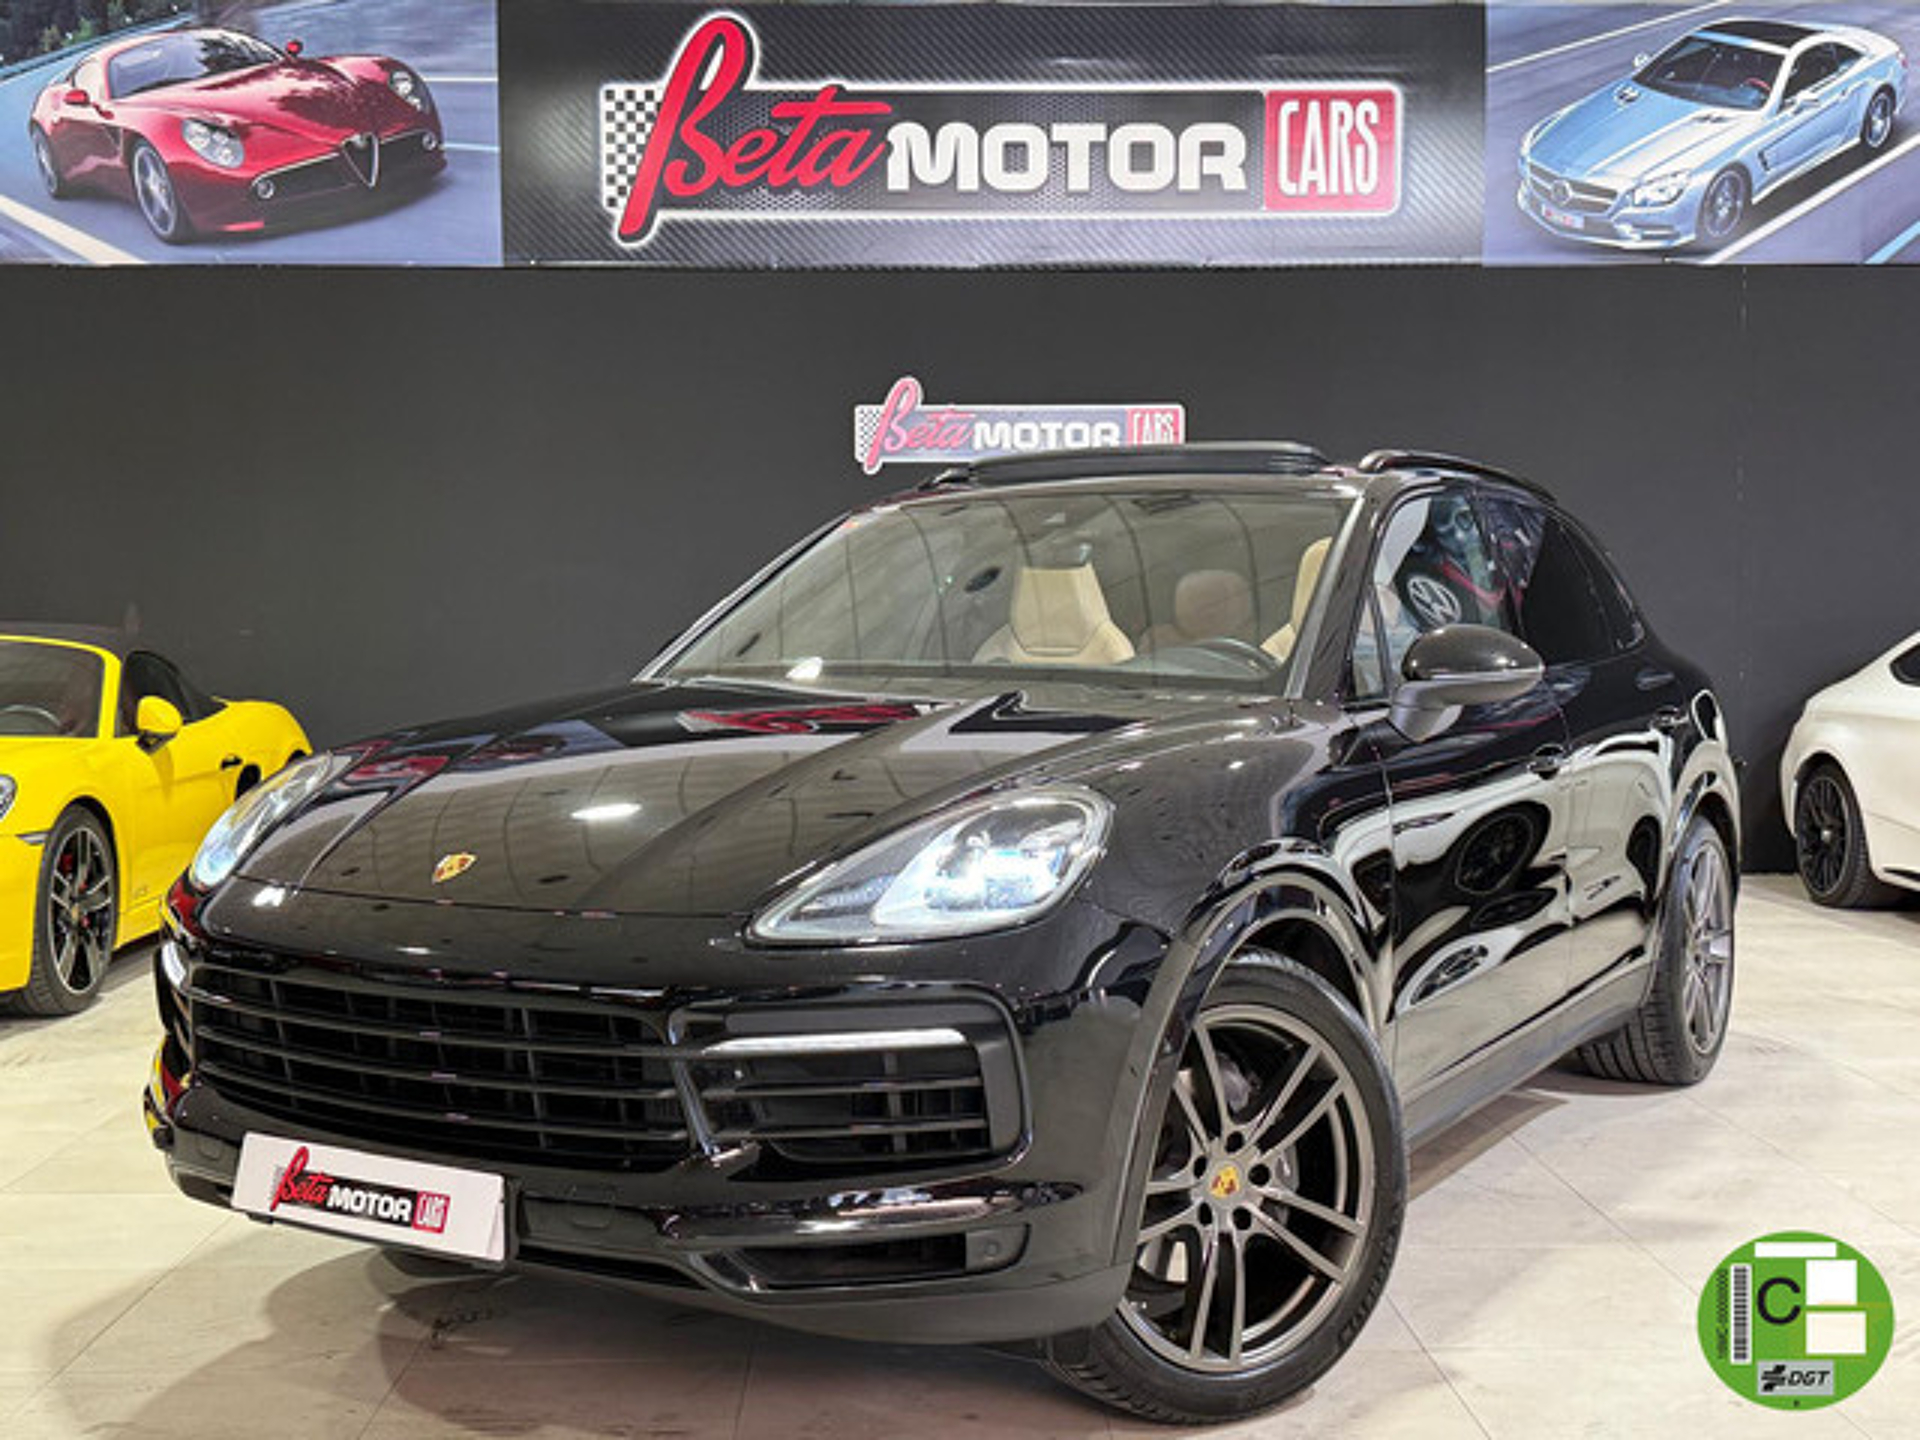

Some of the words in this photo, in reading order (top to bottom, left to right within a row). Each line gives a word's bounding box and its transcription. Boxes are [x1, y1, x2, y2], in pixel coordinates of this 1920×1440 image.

[619, 16, 892, 235] Beta
[886, 121, 1247, 193] MOTOR
[1277, 98, 1379, 199] CARS
[866, 379, 977, 467] Beta
[972, 421, 1121, 450] MOTOR
[1133, 413, 1175, 445] CARS
[270, 1146, 335, 1212] Beta
[326, 1184, 412, 1222] MOTOR
[416, 1194, 446, 1229] CARS
